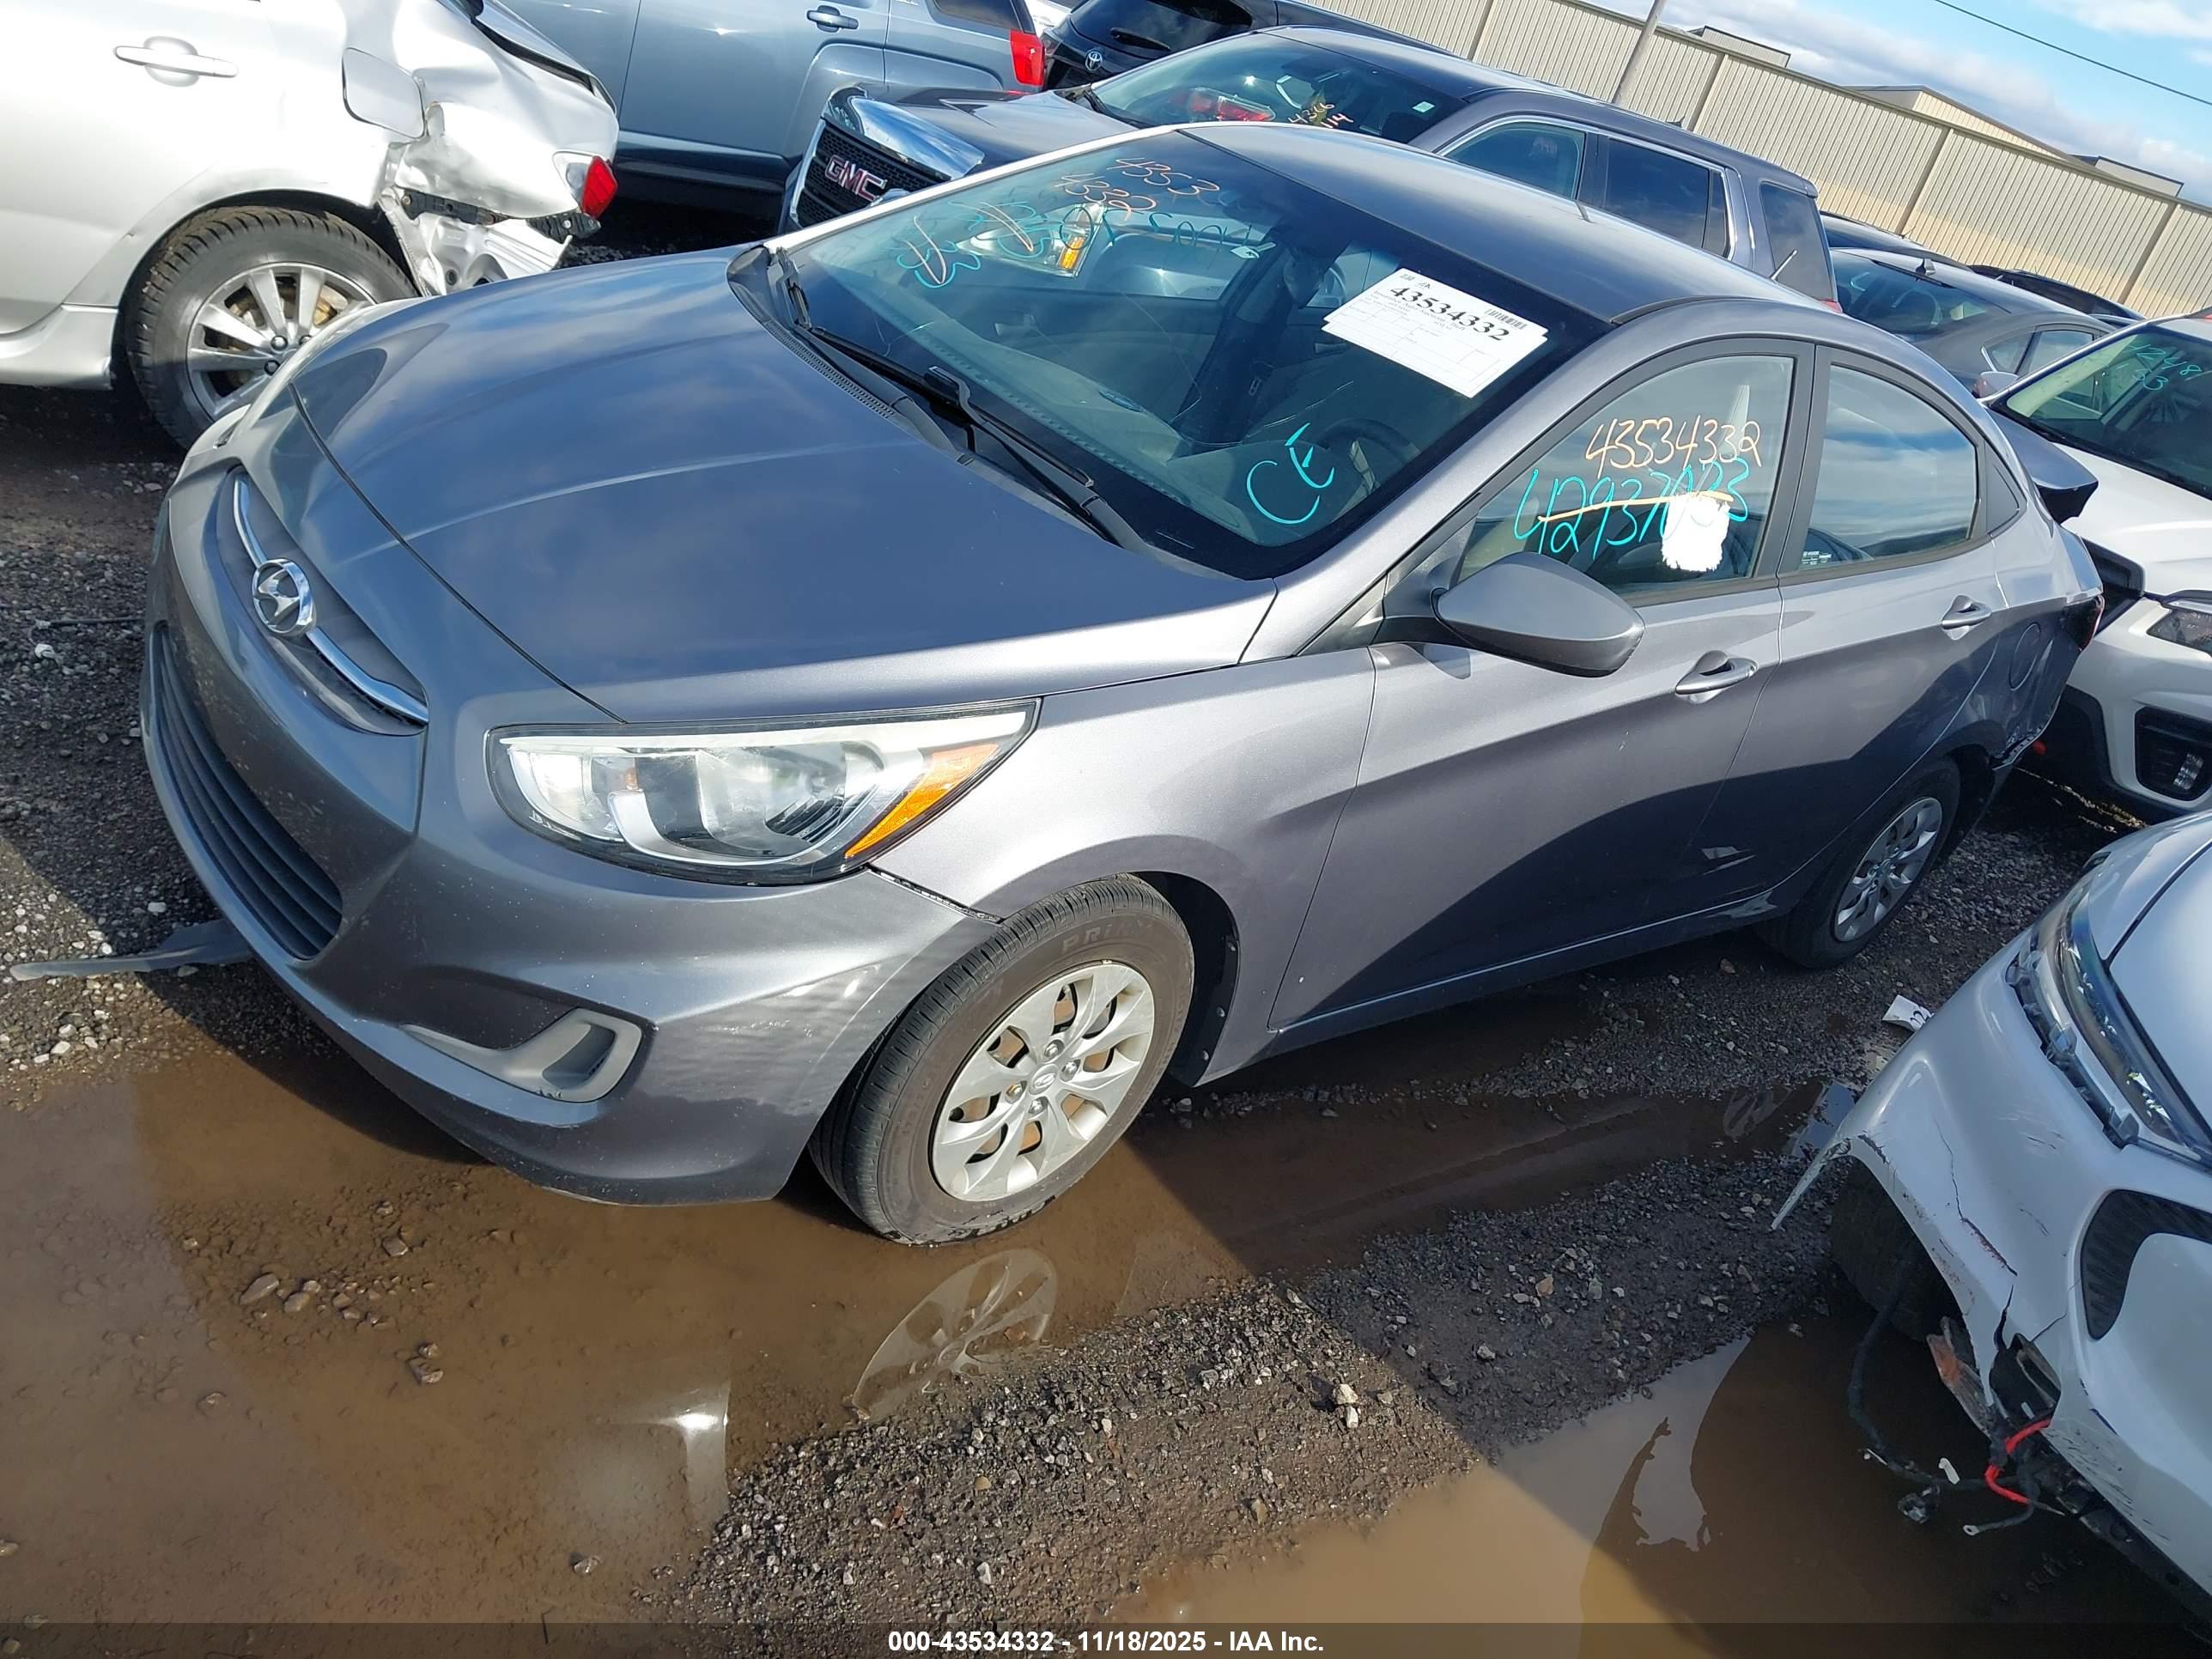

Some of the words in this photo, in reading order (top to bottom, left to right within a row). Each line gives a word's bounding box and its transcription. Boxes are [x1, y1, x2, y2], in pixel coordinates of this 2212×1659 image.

[824, 154, 889, 203] GMC
[1389, 285, 1510, 341] 43534332
[1585, 414, 1762, 479] 43534332
